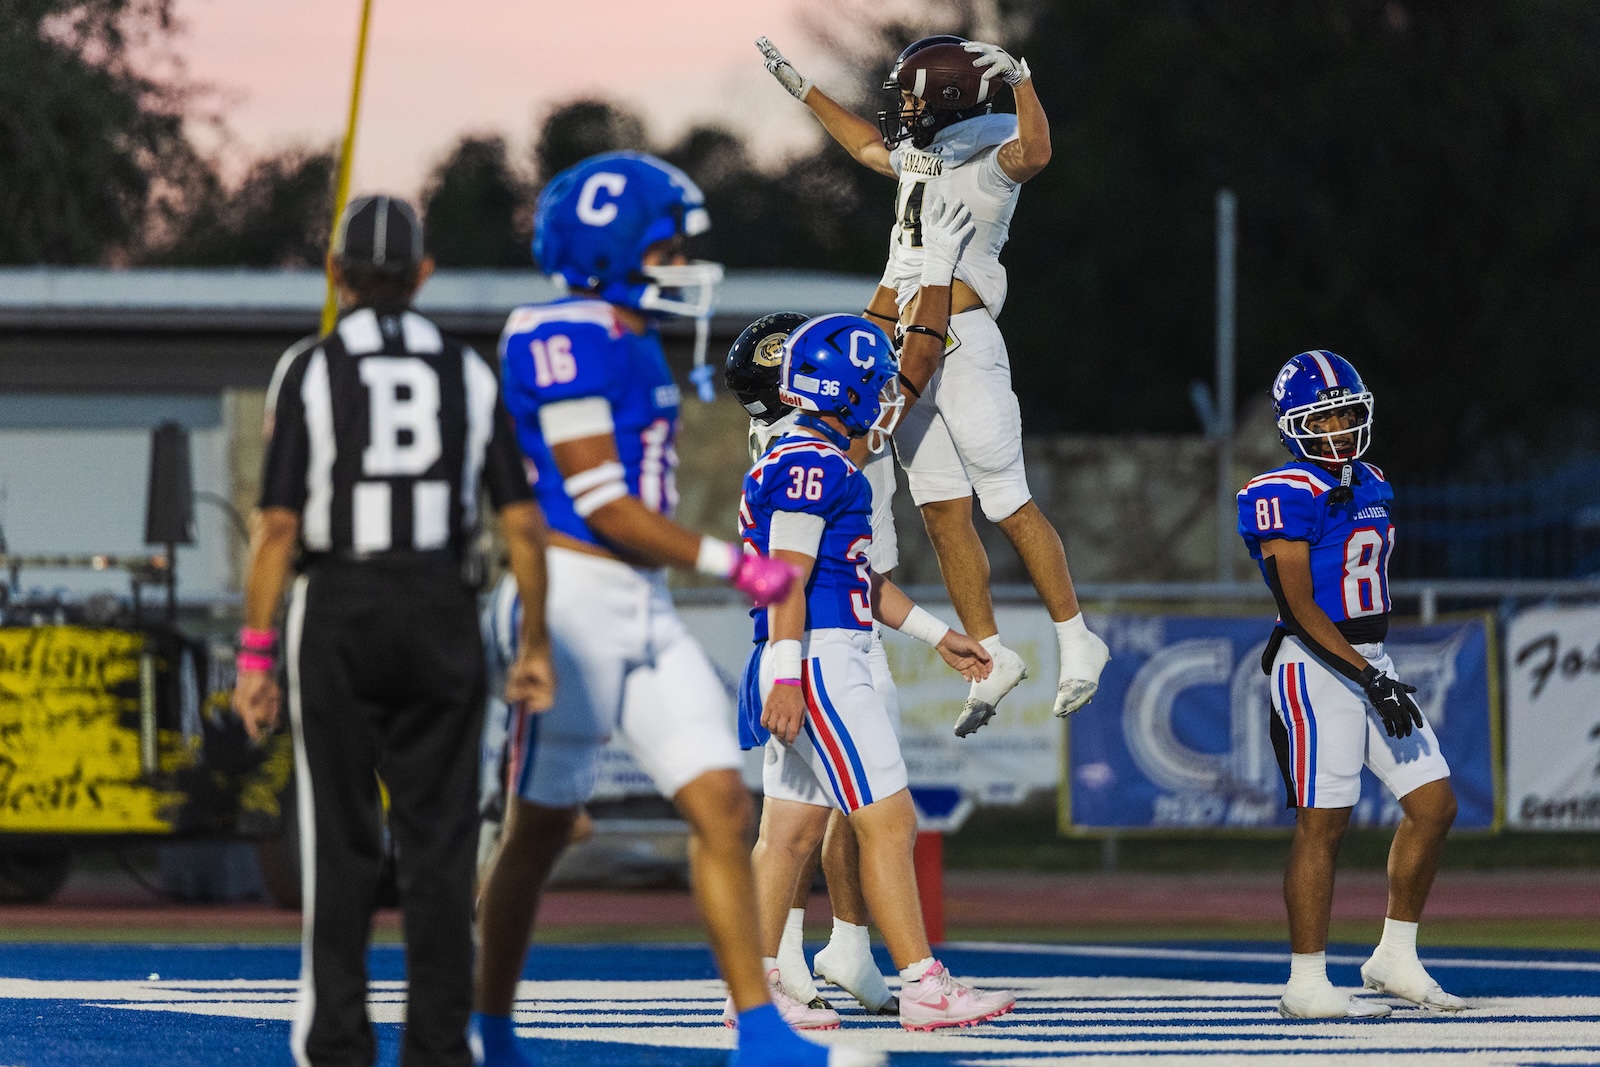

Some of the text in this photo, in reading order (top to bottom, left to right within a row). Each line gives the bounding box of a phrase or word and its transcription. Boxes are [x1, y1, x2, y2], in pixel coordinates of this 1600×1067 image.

[576, 171, 628, 227] C
[530, 334, 577, 388] 16
[849, 329, 876, 370] C
[820, 379, 841, 397] 36
[1272, 363, 1299, 400] C
[358, 356, 443, 477] B
[786, 466, 824, 501] 36
[1255, 497, 1283, 531] 81
